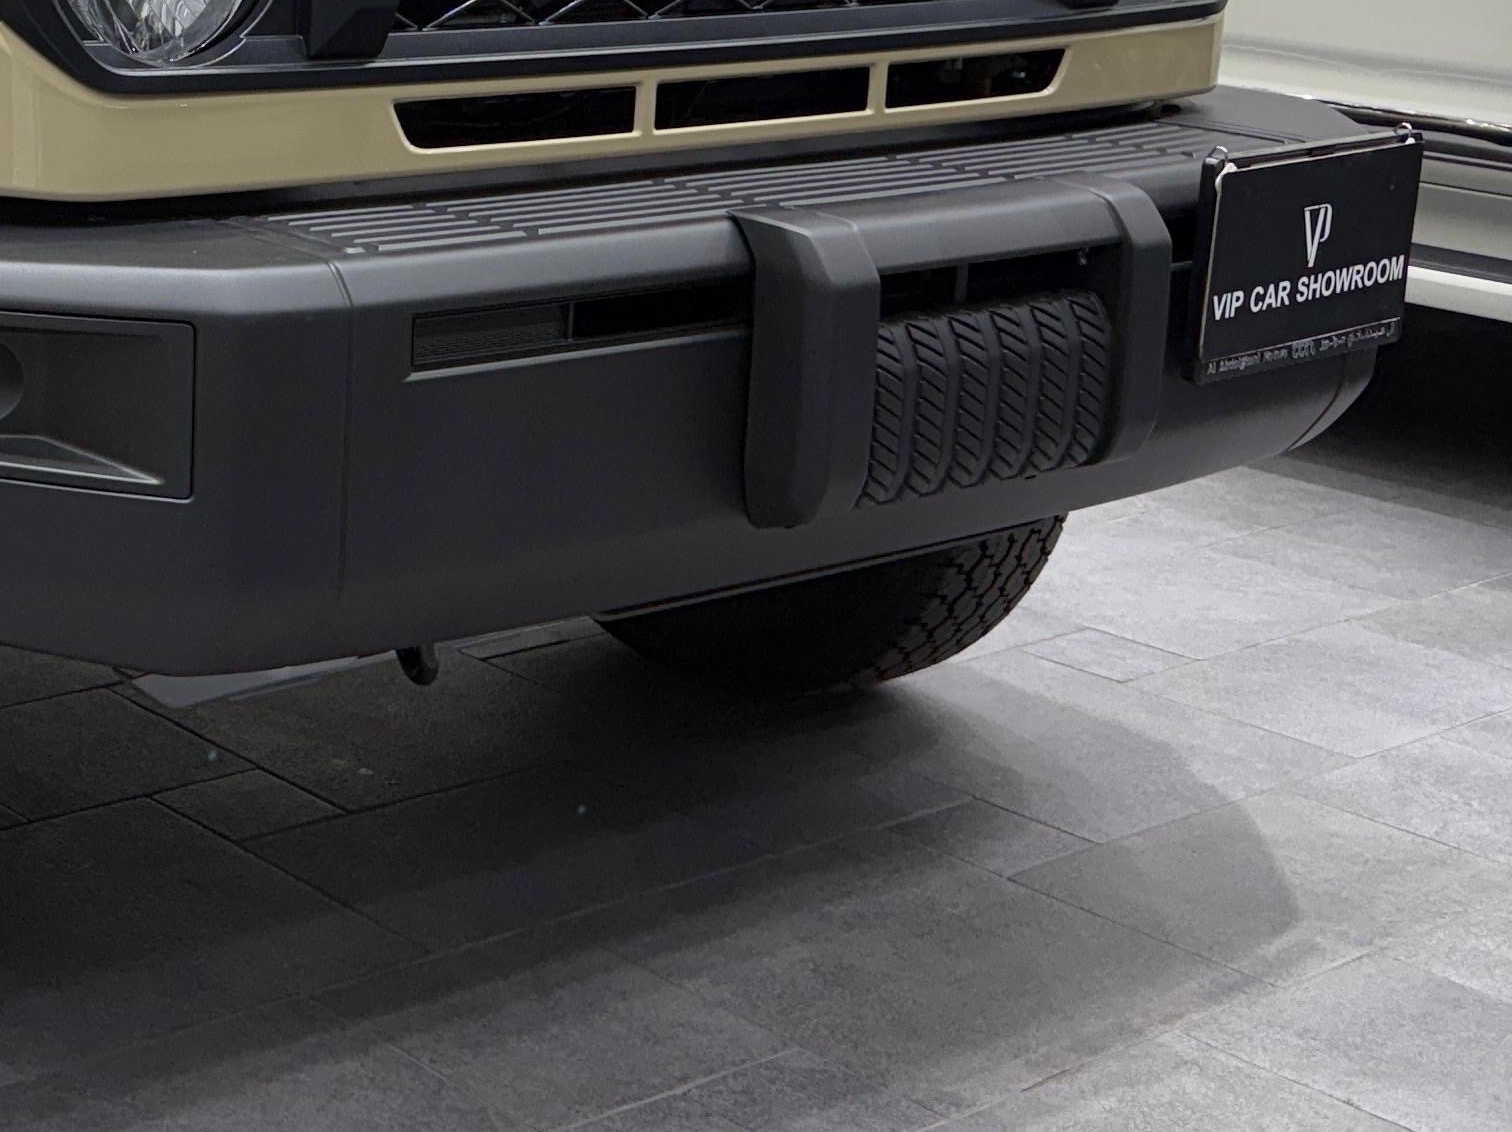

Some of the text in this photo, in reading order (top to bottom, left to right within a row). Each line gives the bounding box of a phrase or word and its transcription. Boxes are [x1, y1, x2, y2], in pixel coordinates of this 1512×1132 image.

[1213, 255, 1405, 320] VIP CAR SHOWROOM
